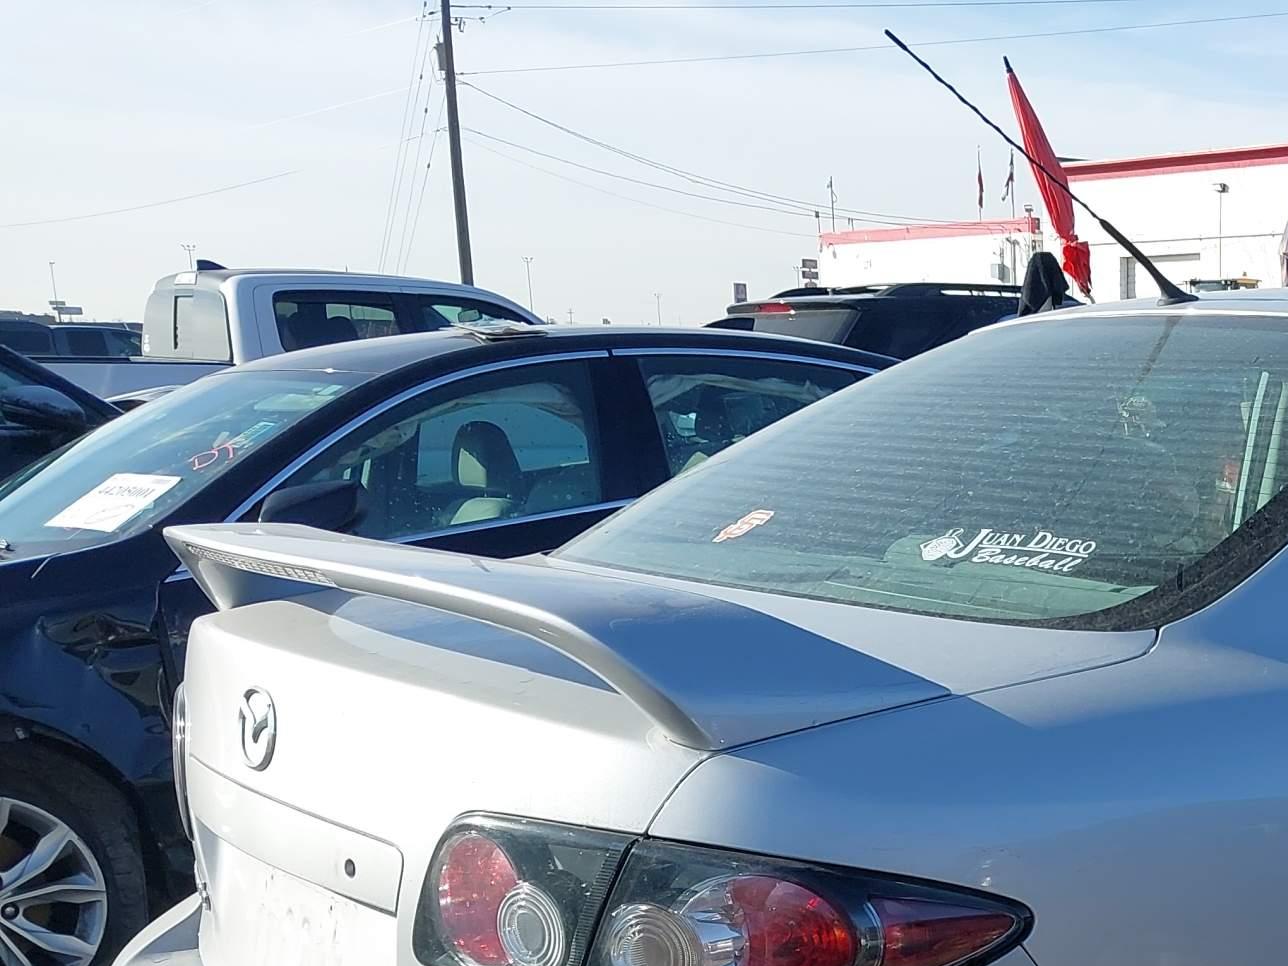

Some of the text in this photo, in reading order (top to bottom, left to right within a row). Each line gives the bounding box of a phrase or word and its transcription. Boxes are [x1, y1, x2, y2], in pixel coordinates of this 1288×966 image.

[946, 528, 1097, 559] JUAN DIEGO
[971, 549, 1083, 572] Baseball
